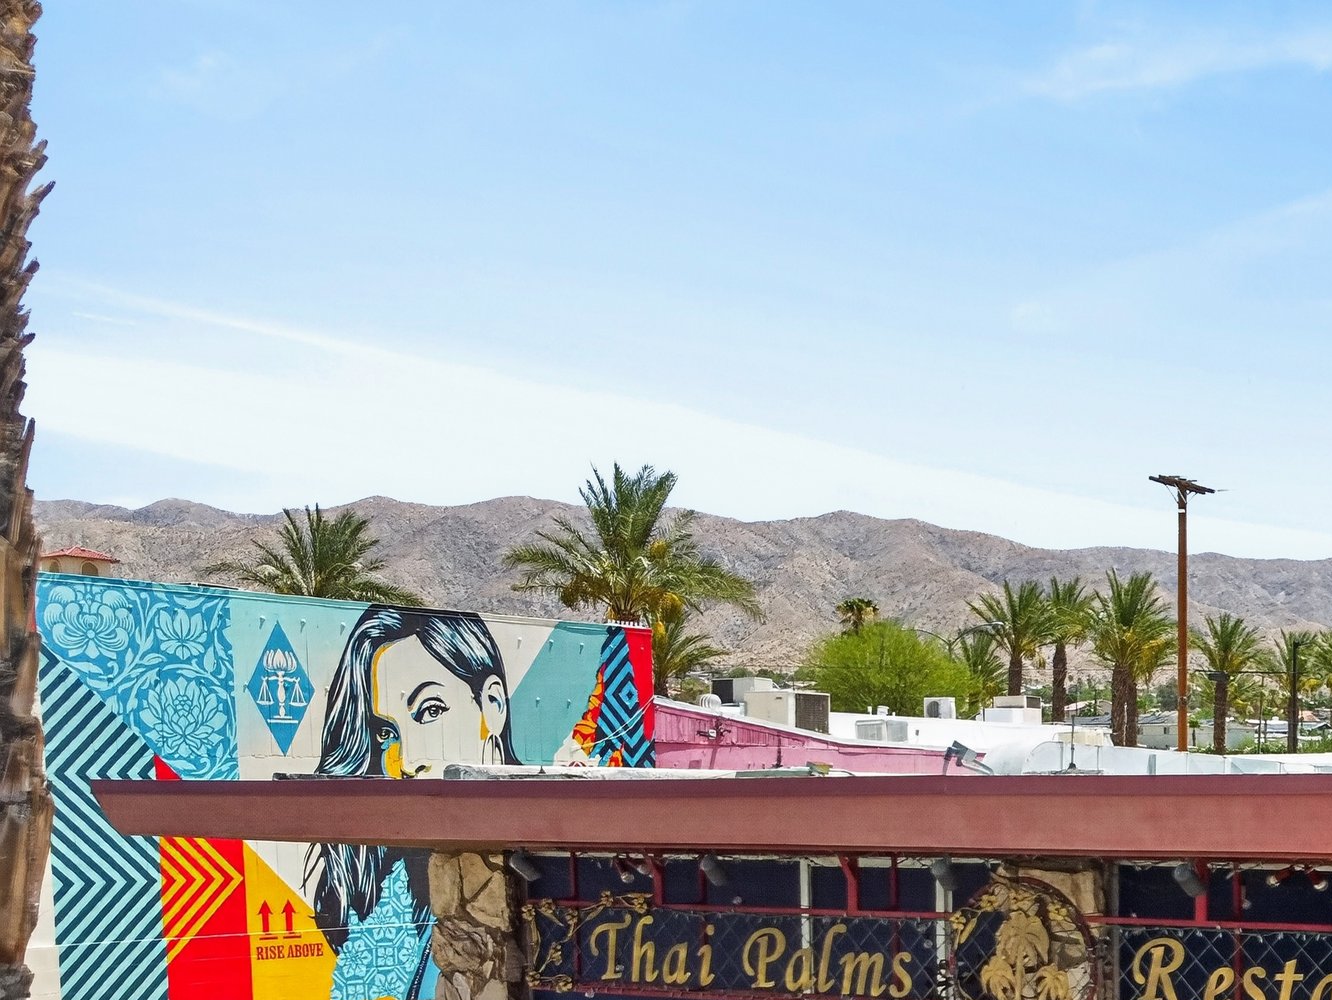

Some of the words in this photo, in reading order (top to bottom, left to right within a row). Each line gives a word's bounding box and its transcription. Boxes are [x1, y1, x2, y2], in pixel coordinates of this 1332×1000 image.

[255, 945, 285, 961] RISE
[287, 942, 324, 959] ABOVE
[589, 912, 715, 987] Thai
[742, 922, 913, 998] Palms
